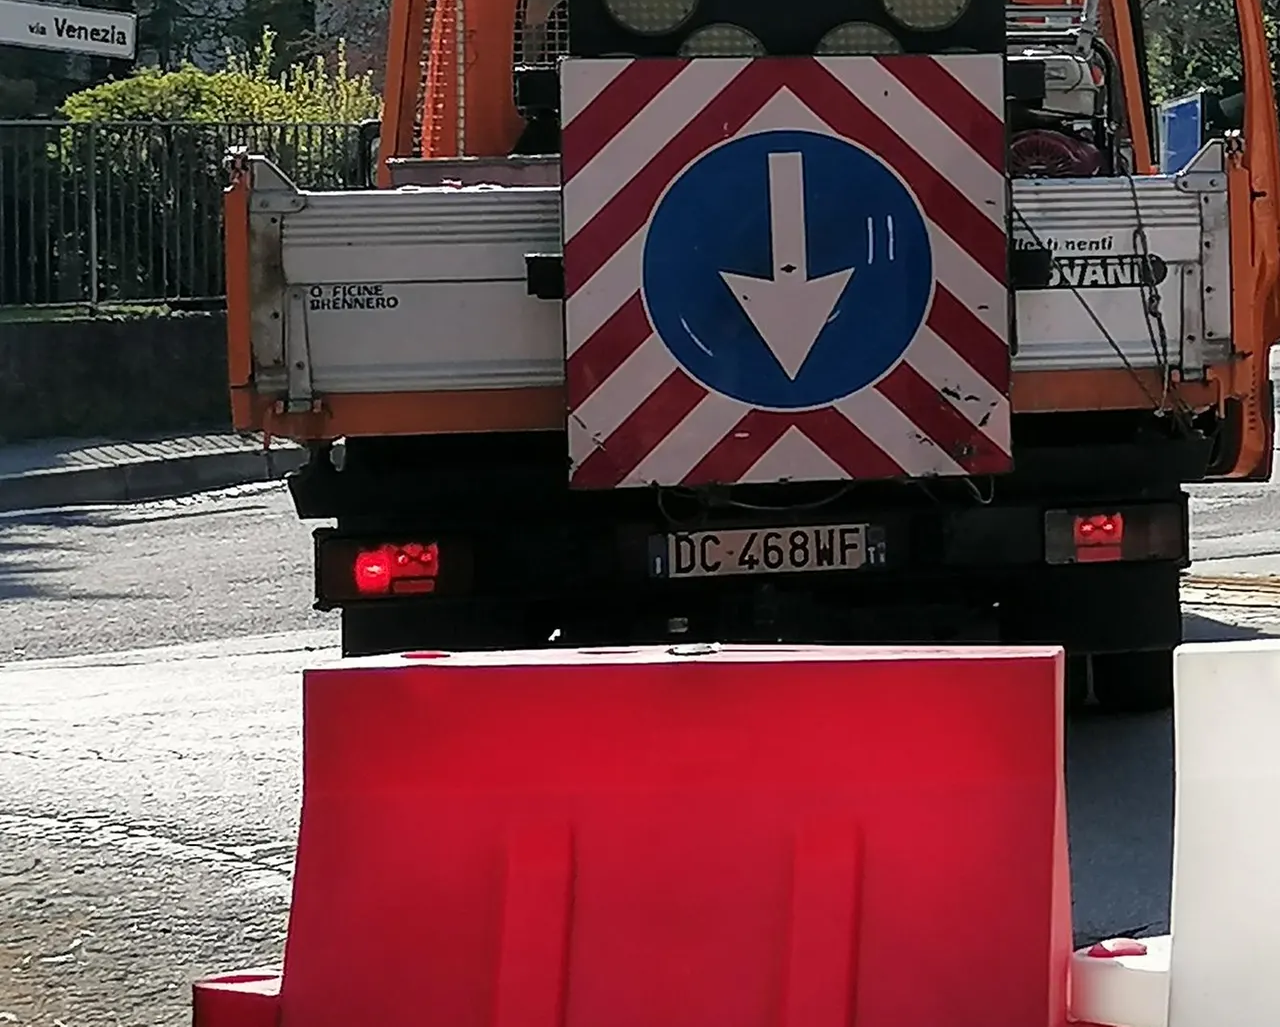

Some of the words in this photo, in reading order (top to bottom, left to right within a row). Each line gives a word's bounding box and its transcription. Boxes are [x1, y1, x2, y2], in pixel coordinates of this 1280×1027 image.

[28, 22, 47, 36] via
[53, 17, 127, 46] Venezia
[310, 296, 399, 311] BRENNERO
[674, 534, 722, 574] DC
[738, 527, 861, 571] 468WF
